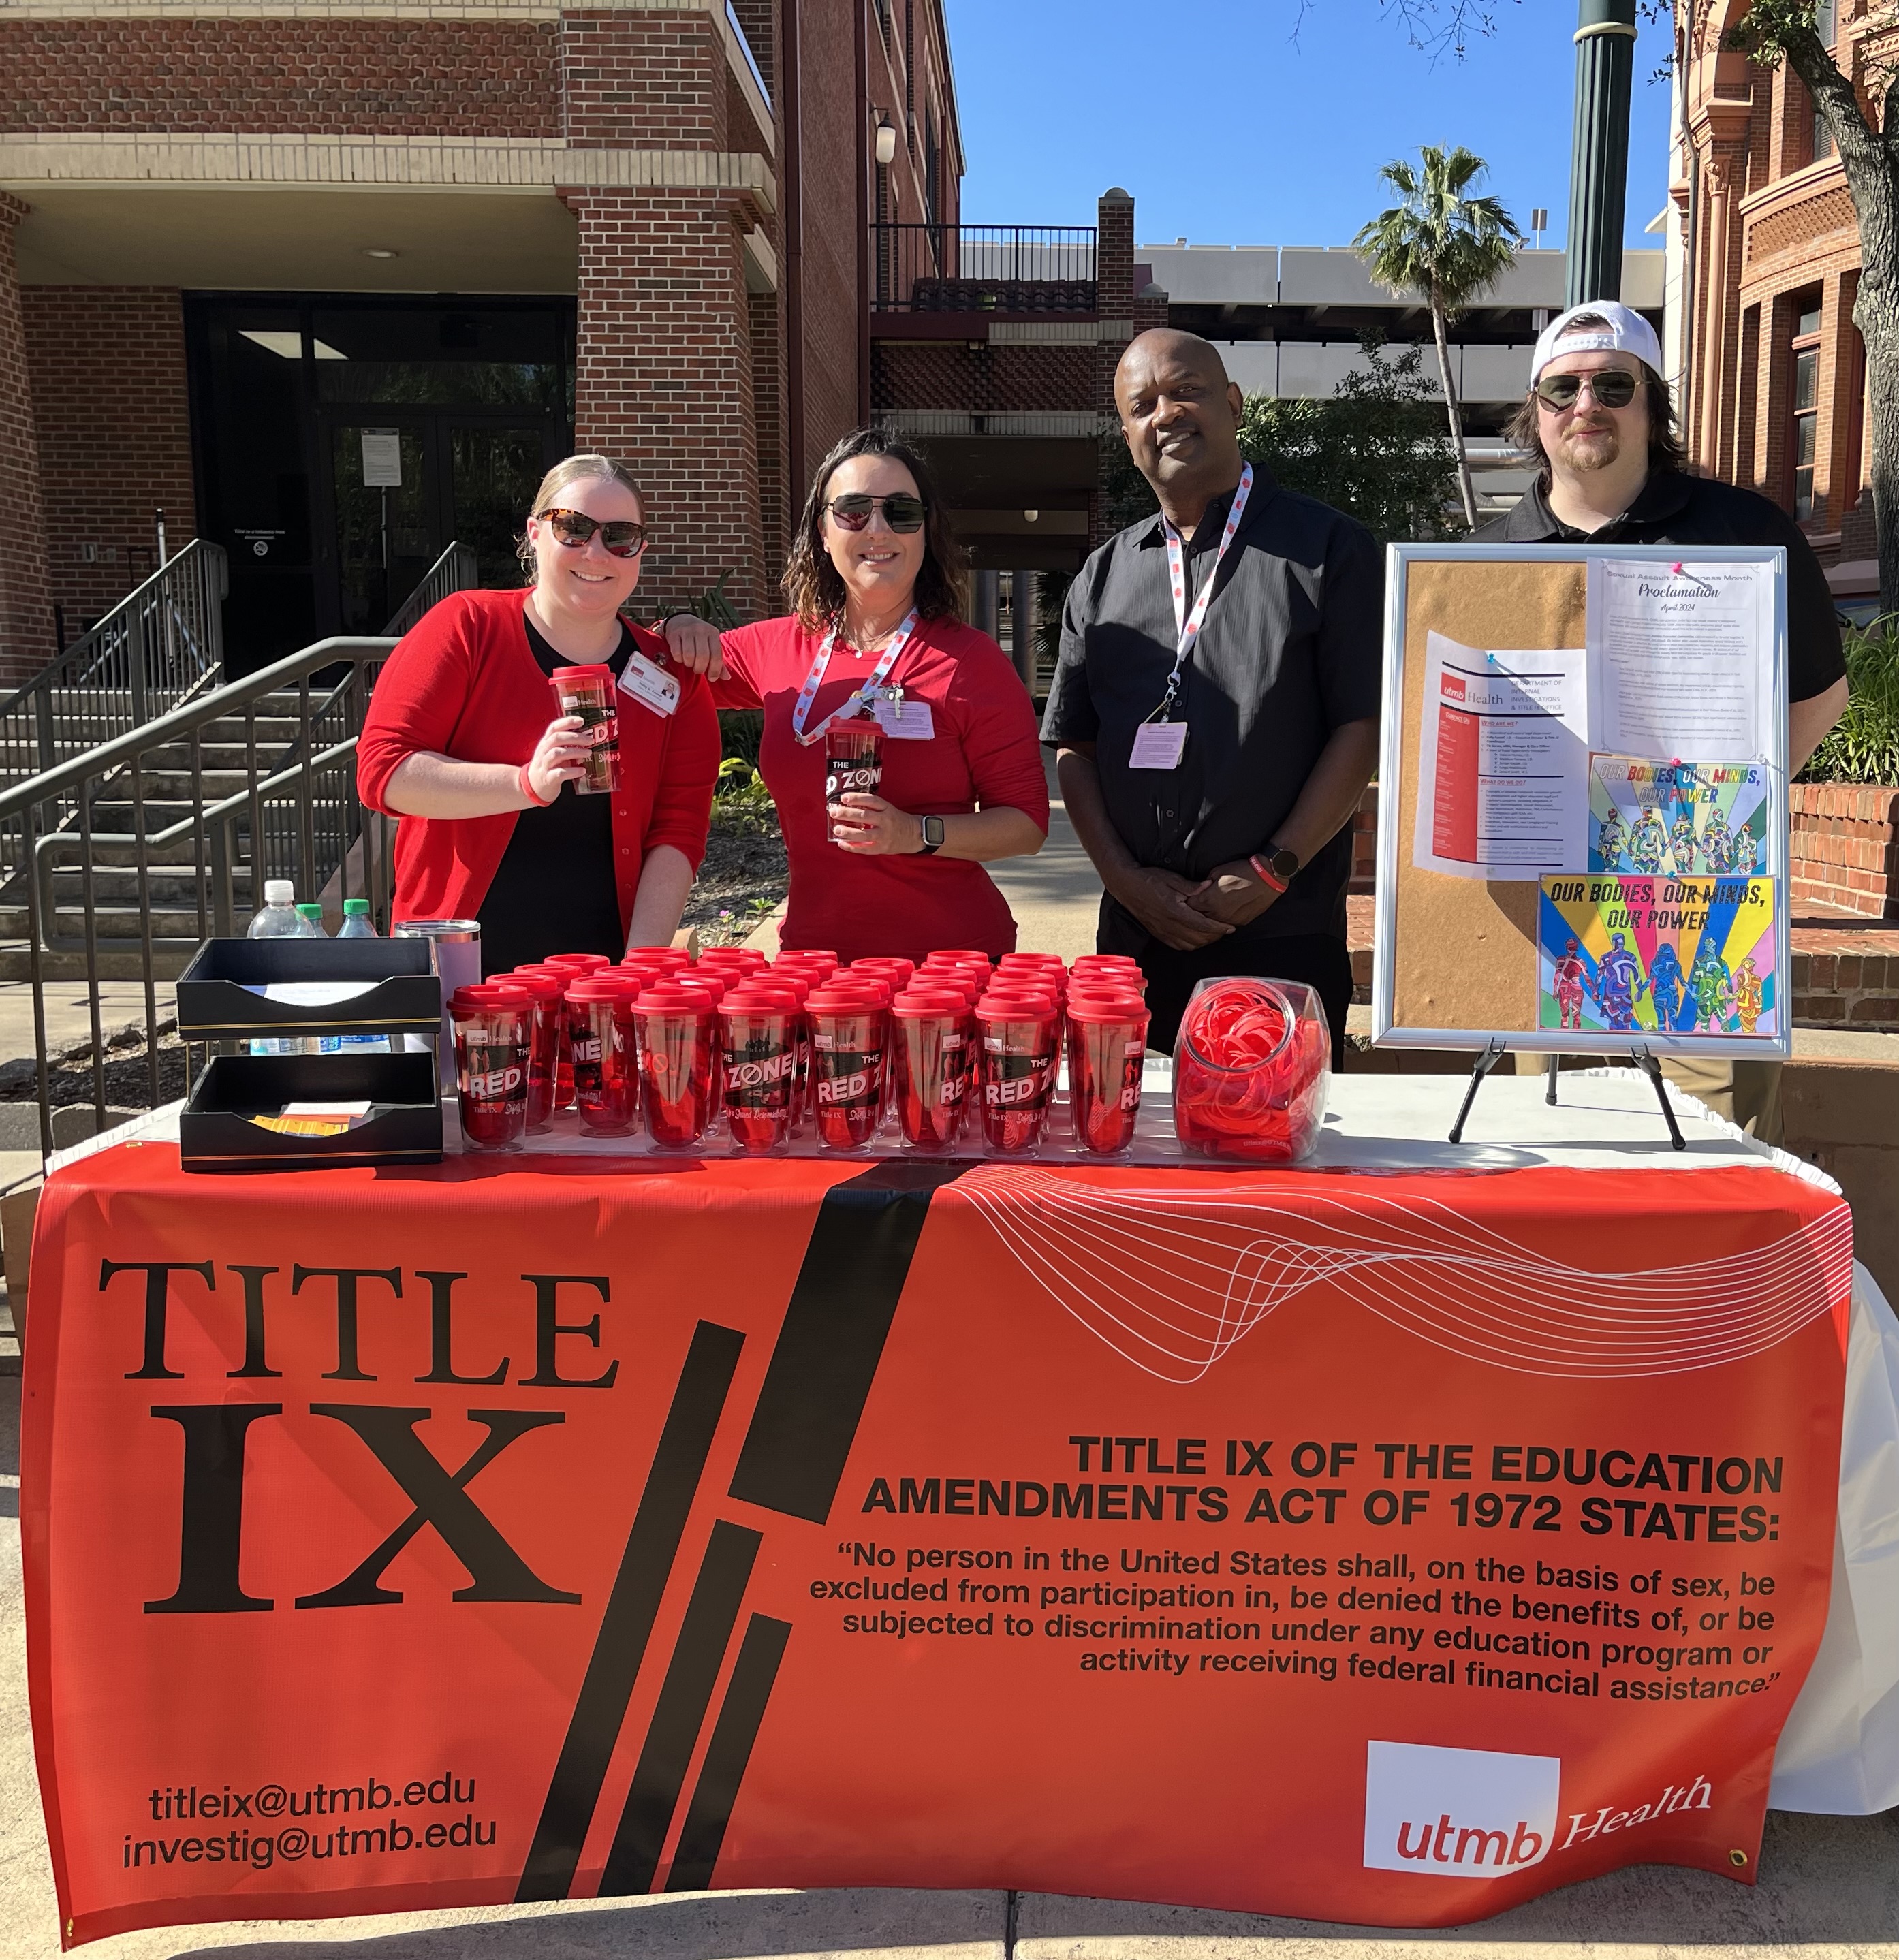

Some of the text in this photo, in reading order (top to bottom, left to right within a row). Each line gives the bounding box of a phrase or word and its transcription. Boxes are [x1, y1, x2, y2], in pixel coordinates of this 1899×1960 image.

[1607, 571, 1635, 579] Sexual
[1639, 583, 1721, 598] Proclamation
[1661, 604, 1678, 613] April
[1443, 686, 1503, 705] utmb Health
[1600, 763, 1760, 787] OUR BODIES, OUR MINDS,
[1639, 787, 1718, 803] OUR POWER
[1551, 883, 1765, 907] OUR BODIES, OUR MINDS,
[1607, 910, 1710, 930] OUR POWER
[517, 1047, 531, 1056] THE
[861, 1054, 879, 1064] THE
[1030, 1058, 1048, 1068] THE
[470, 1068, 521, 1098] RED
[818, 1075, 866, 1103] RED
[941, 1075, 964, 1105] RE
[986, 1078, 1035, 1105] RED
[988, 1112, 1000, 1120] Title
[99, 1259, 620, 1388] TITLE
[1069, 1436, 1783, 1494] TITLE IX OF THE EDUCATION
[143, 1402, 582, 1613] IX
[862, 1478, 1778, 1542] AMENDMENTS ACT OF 1972 STATES:
[839, 1543, 1774, 1600] “No person in the United States shall, on the basis of sex, be
[811, 1577, 1774, 1636] excluded from participation in, be denied the benefits of, or be
[843, 1611, 1773, 1671] subjected to discrimination under any education program or
[1081, 1649, 1190, 1675] activity
[1200, 1650, 1336, 1681] receiving
[1348, 1653, 1454, 1684] federal
[1465, 1662, 1598, 1696] financial
[149, 1771, 477, 1820] titleix@utmb.edu
[1396, 1774, 1712, 1865] utmb Health
[123, 1814, 497, 1869] investig@utmb.edu
